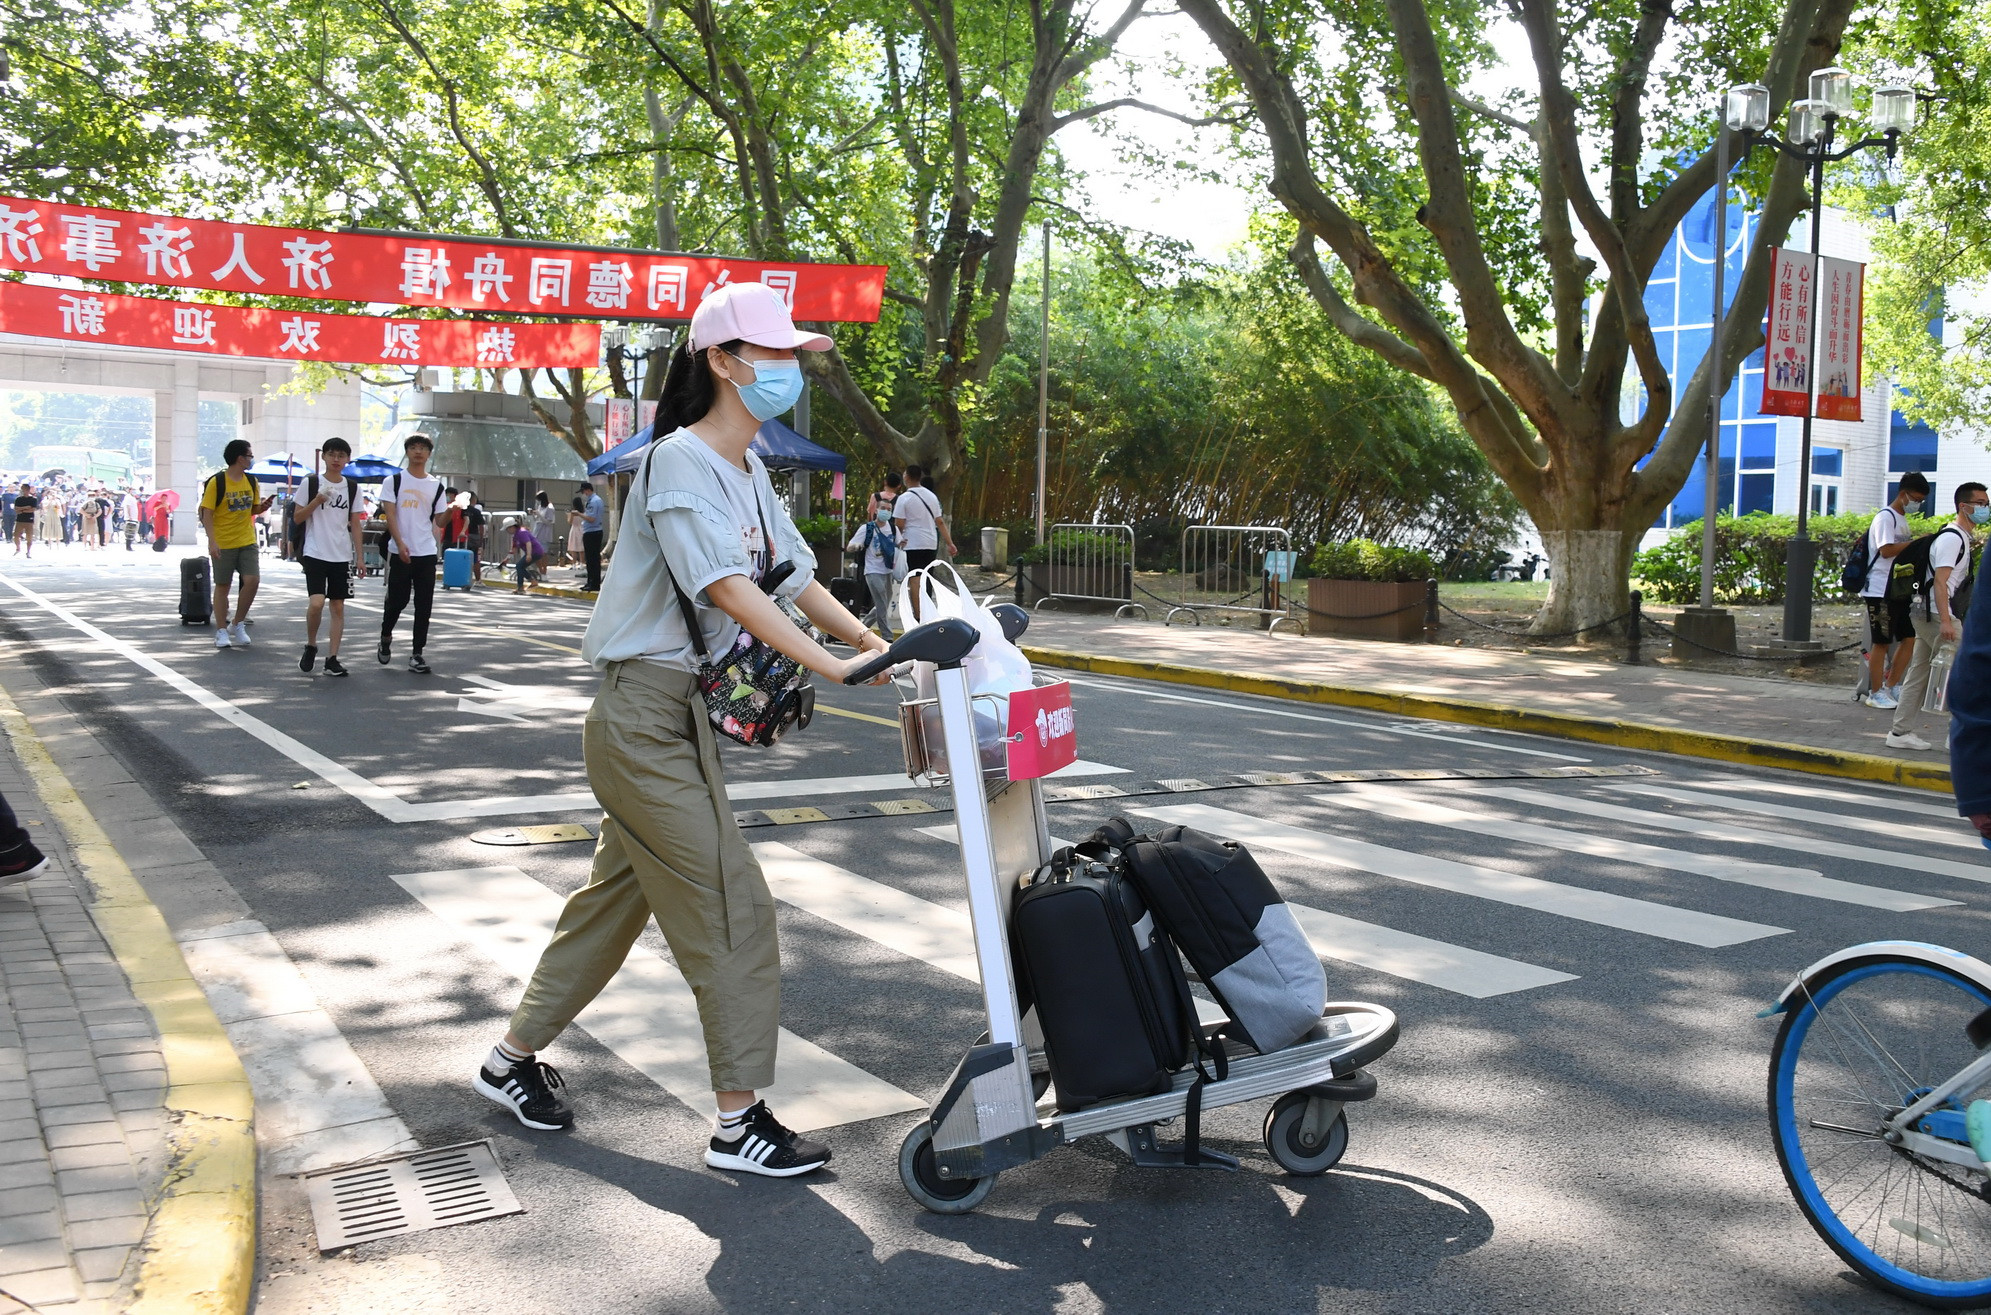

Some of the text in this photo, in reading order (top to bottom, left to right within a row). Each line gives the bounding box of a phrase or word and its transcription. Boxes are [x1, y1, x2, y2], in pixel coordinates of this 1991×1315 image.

[1777, 261, 1793, 342] 方能行远
[1795, 264, 1810, 344] 心有所信
[1828, 269, 1840, 363] 人生因奋斗而升华
